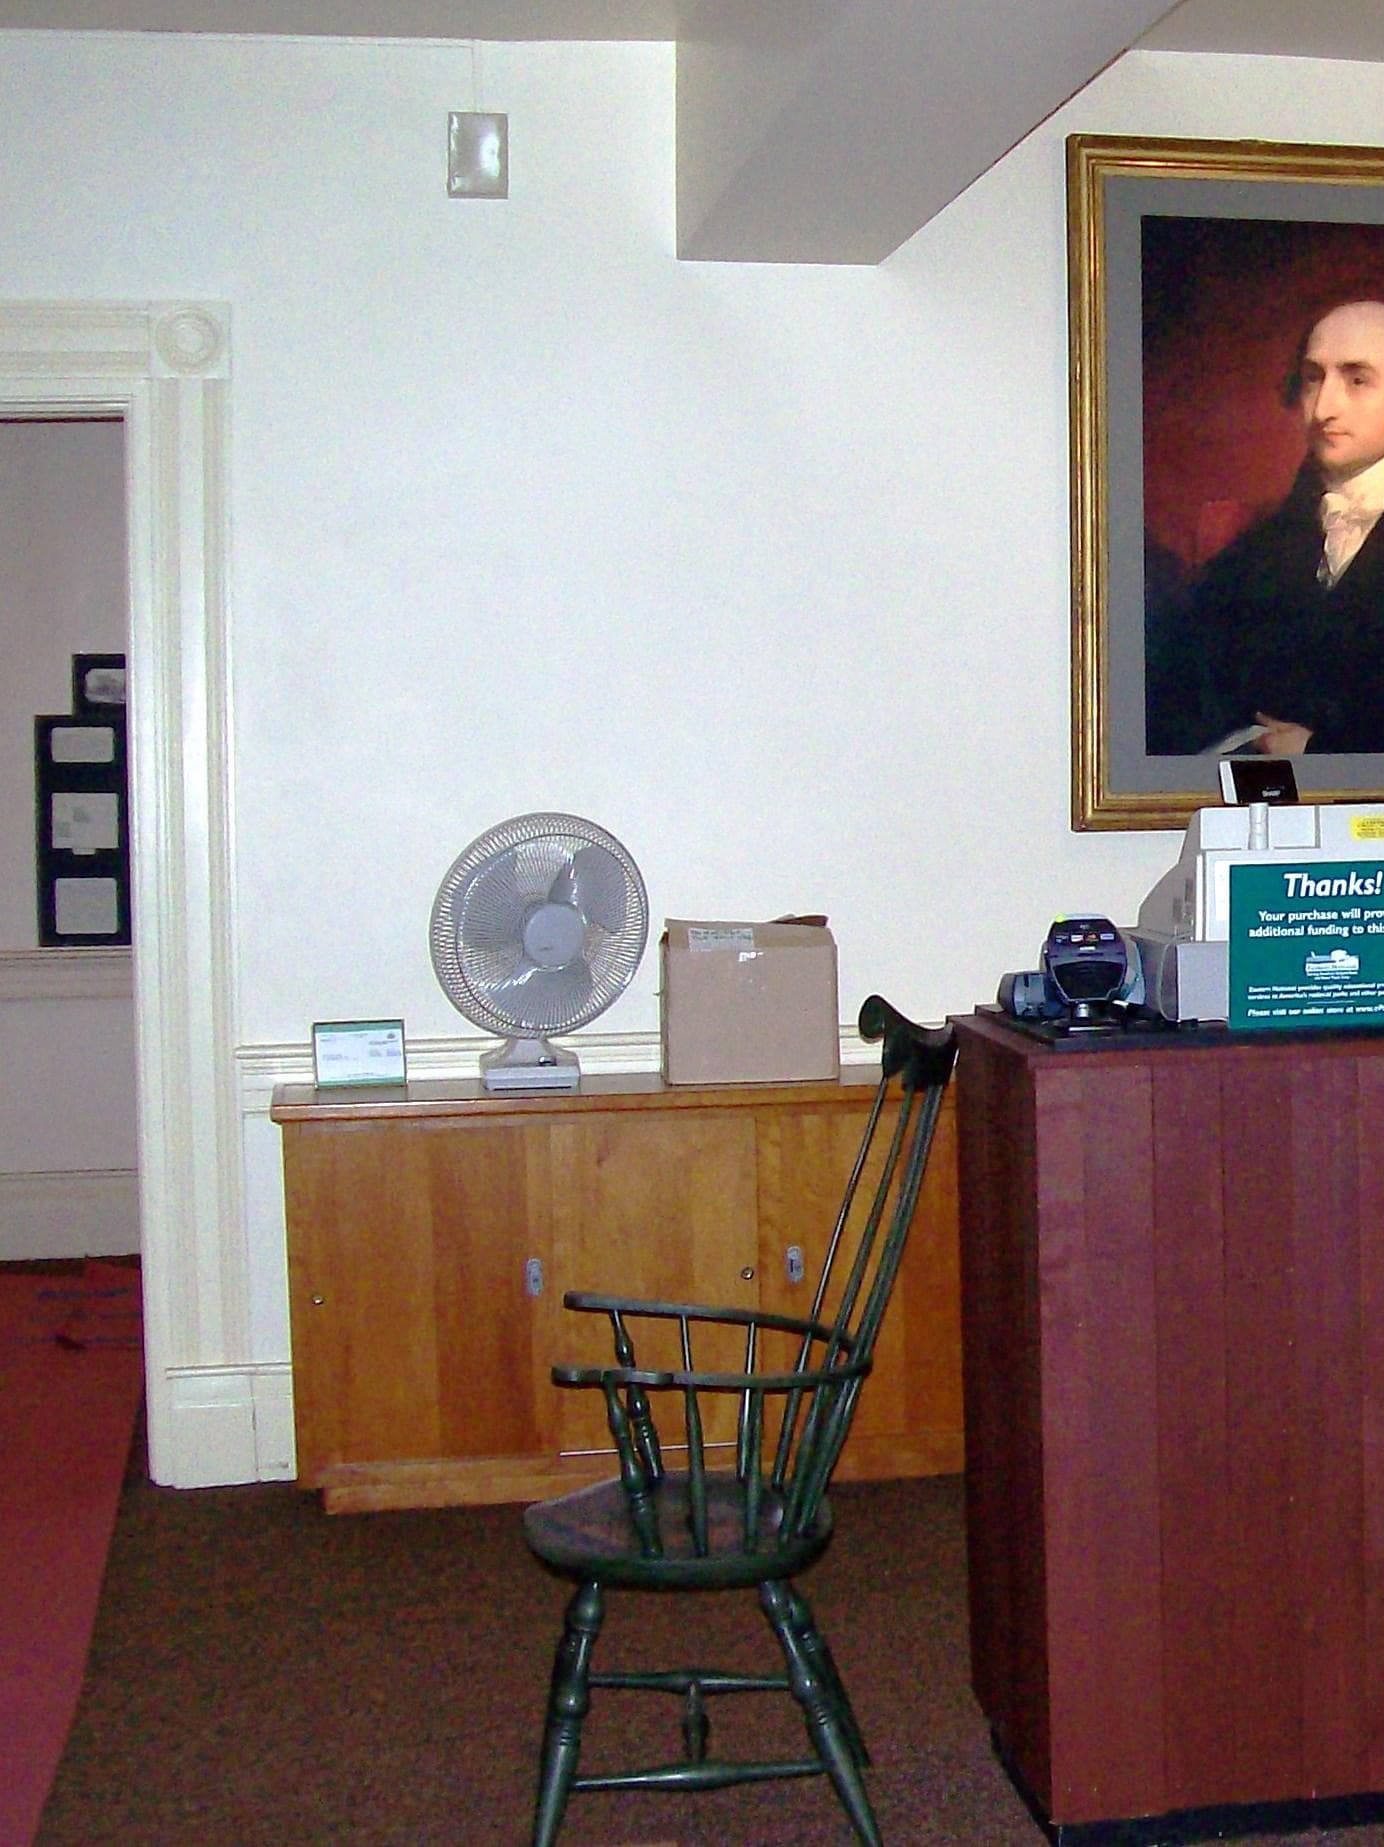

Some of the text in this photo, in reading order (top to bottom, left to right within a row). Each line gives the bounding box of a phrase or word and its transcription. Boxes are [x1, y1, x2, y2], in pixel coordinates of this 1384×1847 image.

[1283, 870, 1384, 898] Thanks!
[1258, 910, 1285, 922] Your
[1288, 909, 1338, 924] purchase
[1341, 907, 1361, 919] will
[1249, 925, 1304, 938] additional
[1307, 924, 1349, 938] funding
[1352, 925, 1364, 934] to
